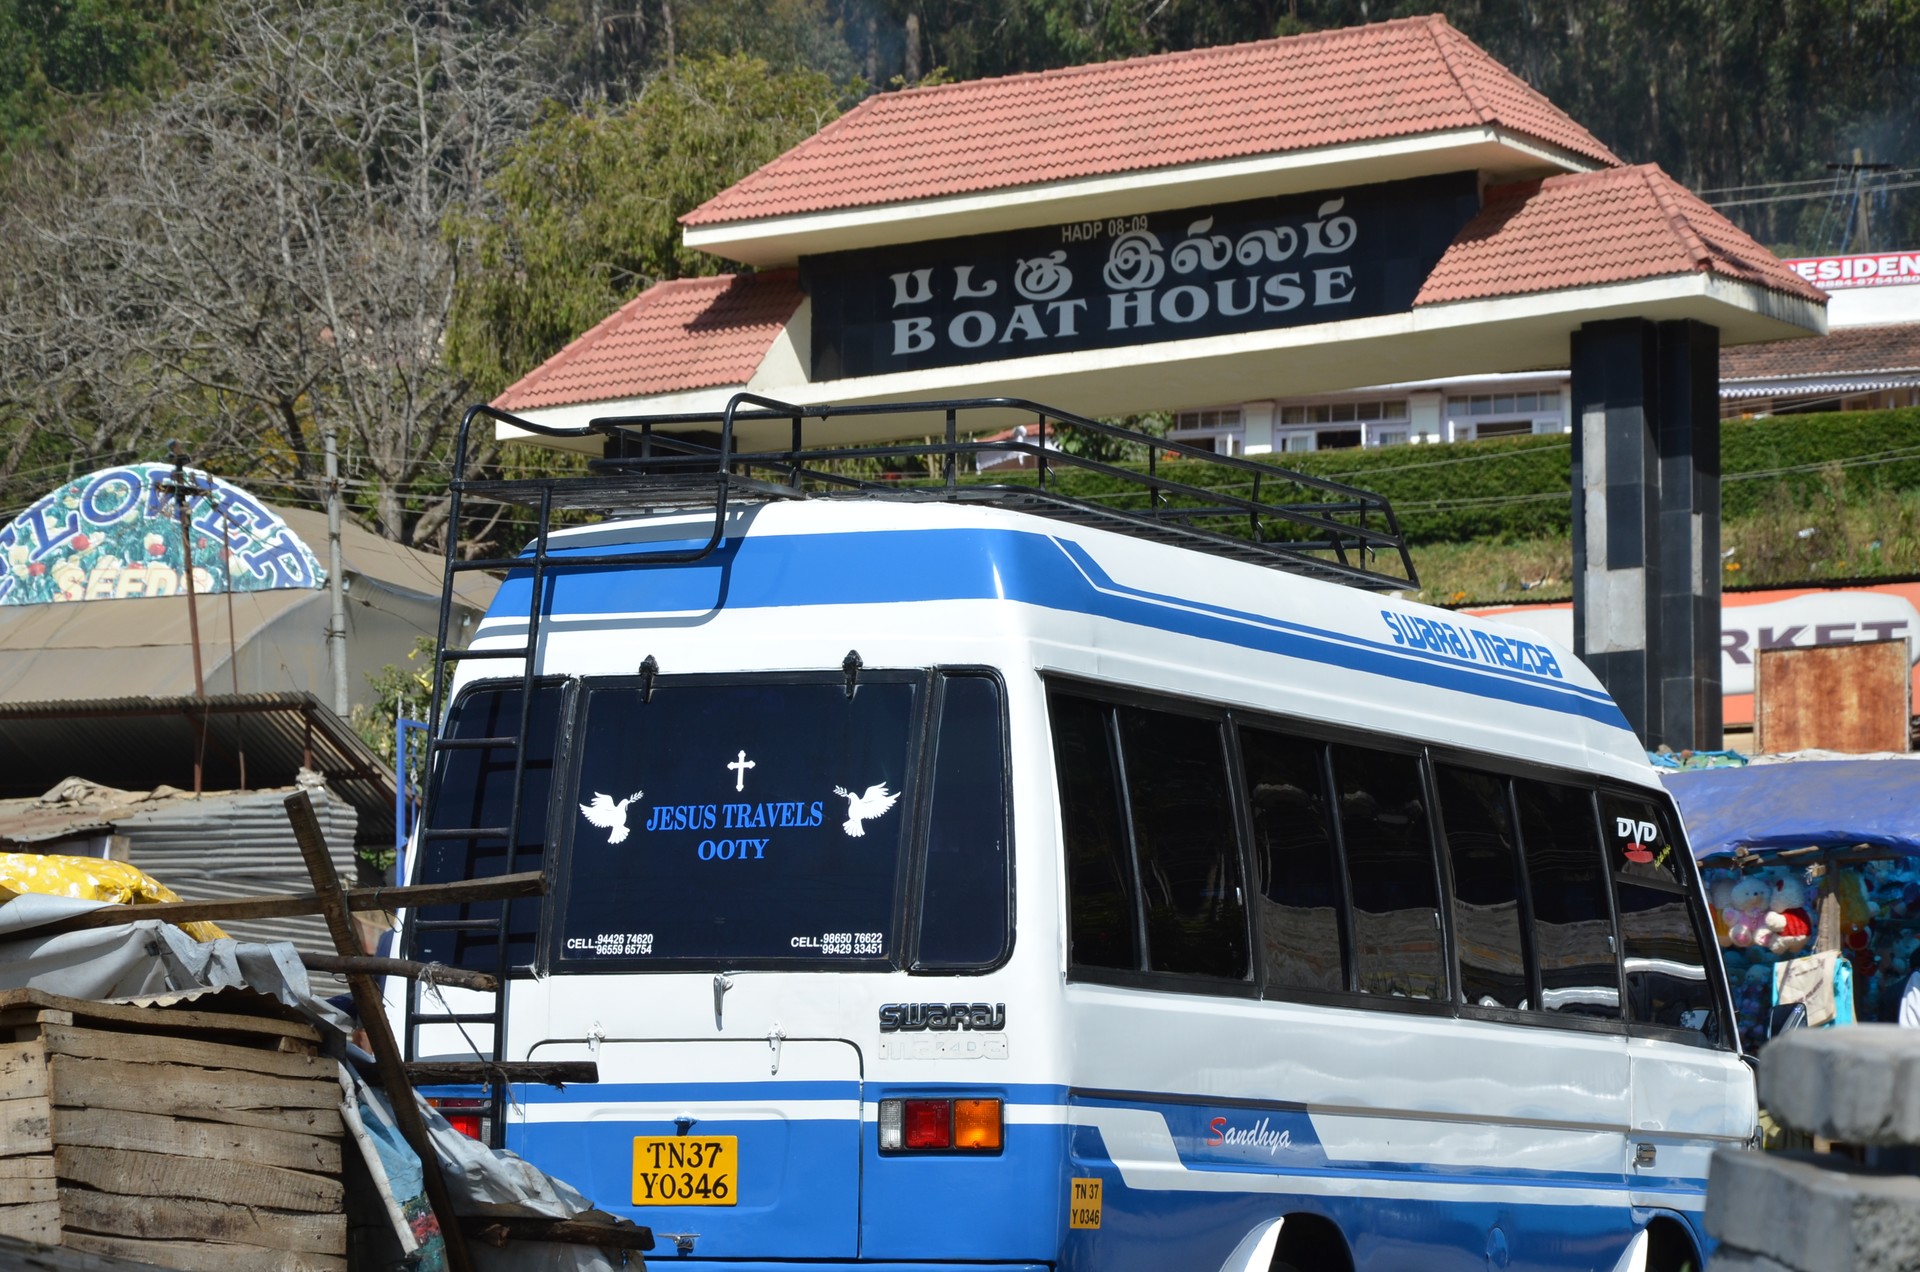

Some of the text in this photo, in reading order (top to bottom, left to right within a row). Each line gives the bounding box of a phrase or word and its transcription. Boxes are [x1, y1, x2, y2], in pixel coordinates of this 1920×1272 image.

[1062, 215, 1148, 243] HADP 08-09
[1103, 196, 1358, 291] இல்லம்
[1789, 255, 1920, 281] ESIDEN
[891, 265, 1357, 356] BOAT HOUSE
[646, 801, 824, 832] JESUS TRAVELS
[1616, 816, 1658, 849] DVD
[697, 838, 769, 861] OOTY
[596, 944, 652, 955] 96559 65754
[597, 933, 624, 945] 94426
[626, 933, 653, 944] 74620
[822, 943, 883, 954] 99429 33451
[823, 932, 852, 944] 98650
[854, 932, 883, 944] 76622
[1207, 1116, 1292, 1156] Sandhya
[646, 1142, 723, 1169] TN37
[640, 1172, 728, 1199] Y0346
[1075, 1184, 1099, 1200] TN 37
[1072, 1209, 1100, 1225] Y 0346
